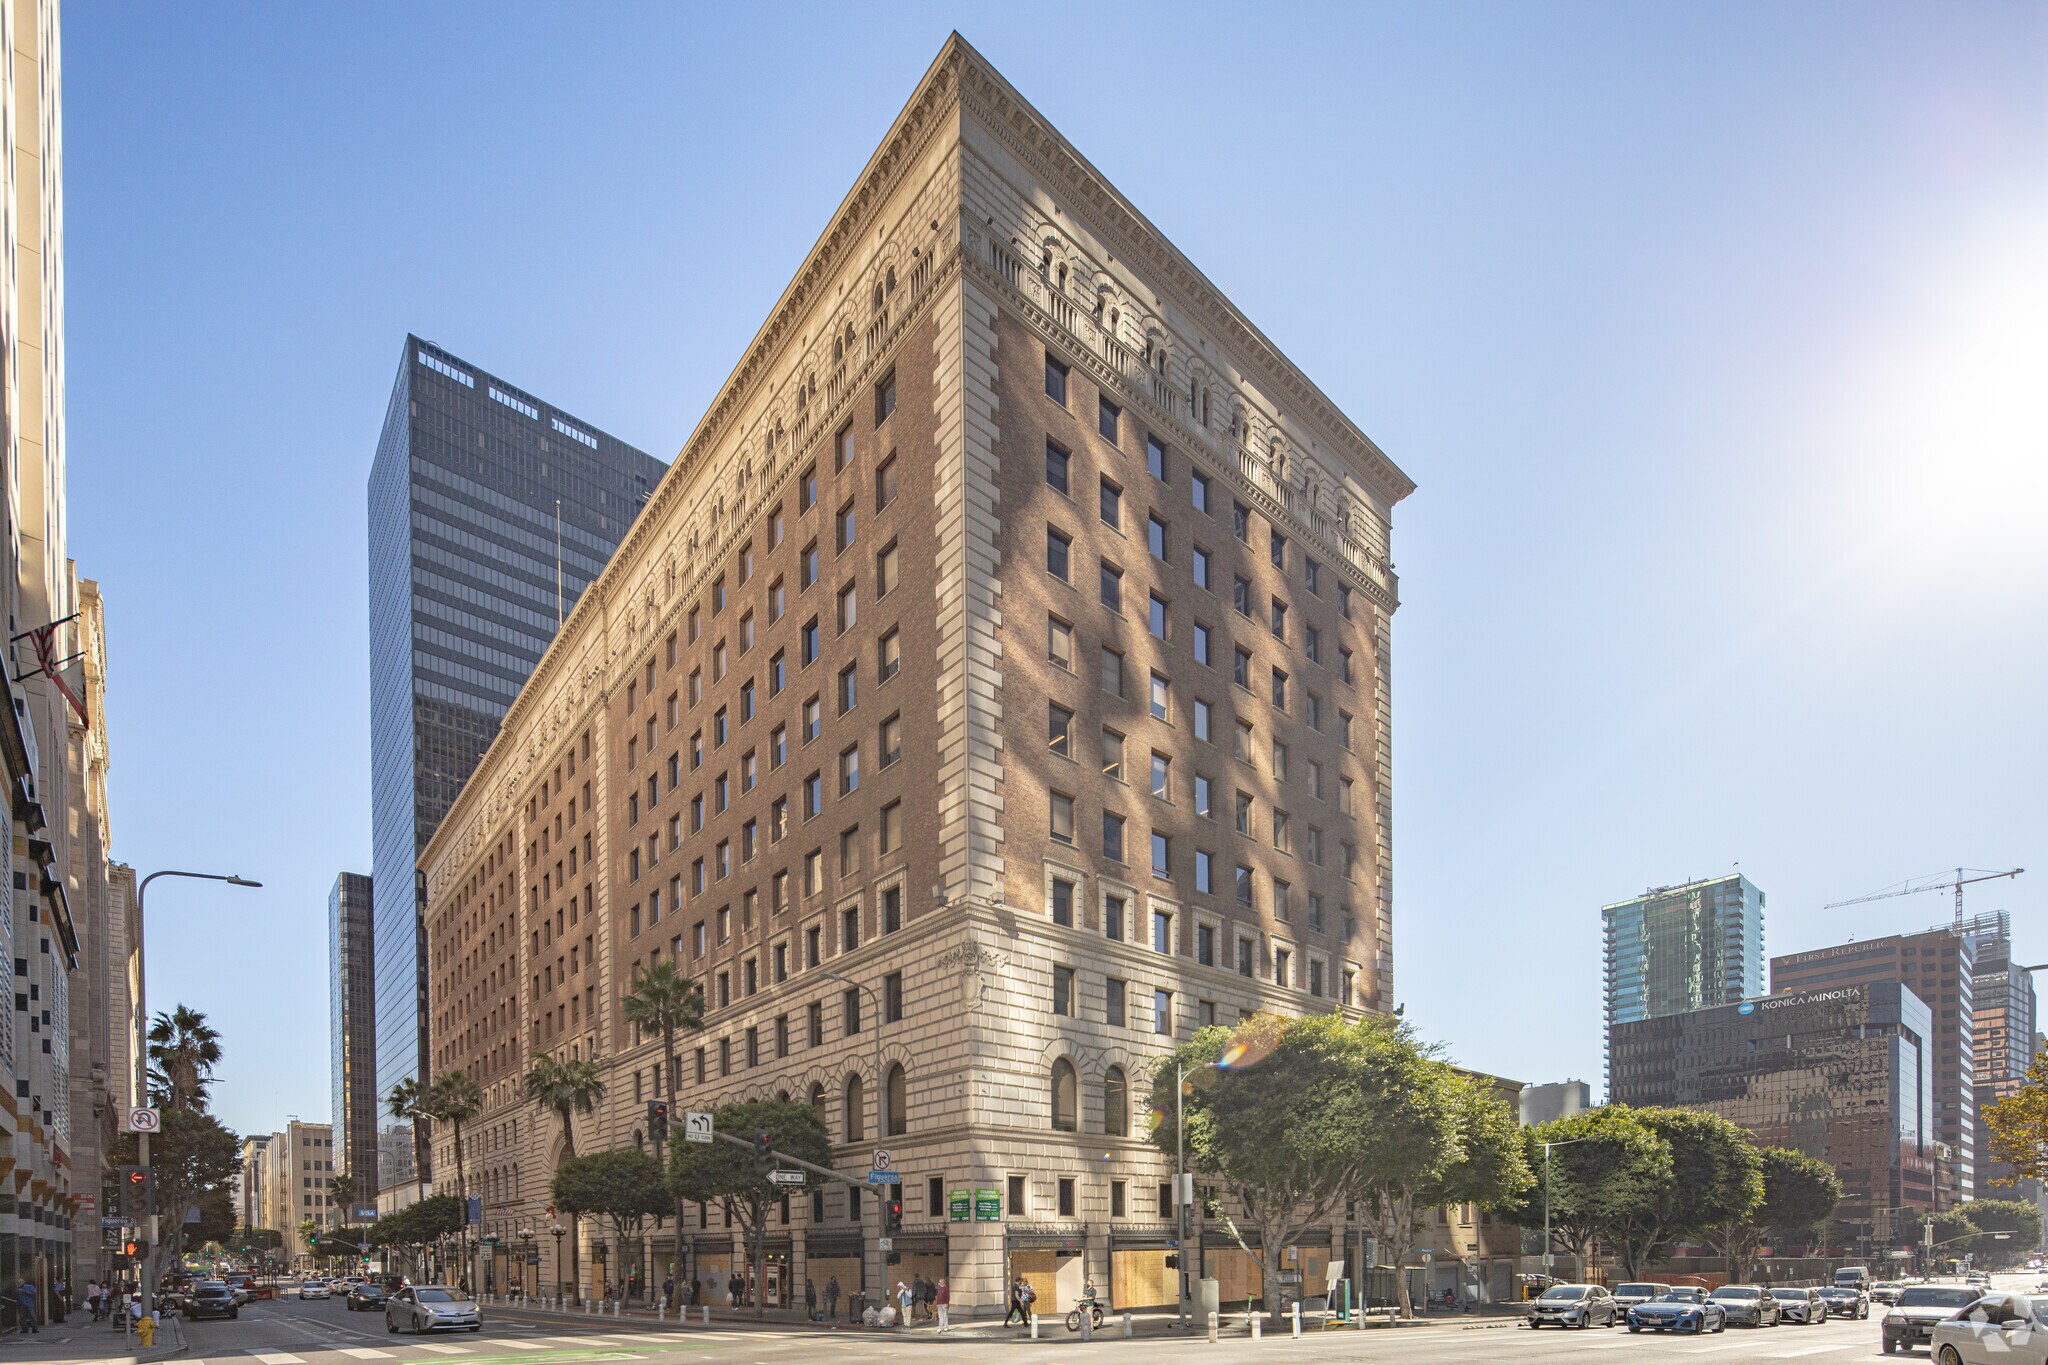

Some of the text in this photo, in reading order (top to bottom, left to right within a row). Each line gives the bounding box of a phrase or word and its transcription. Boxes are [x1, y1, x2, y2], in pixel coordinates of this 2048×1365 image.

[1796, 940, 1888, 963] FIRST REPUBLIC
[1761, 988, 1860, 1011] KONICA MINOLTA
[870, 1173, 898, 1182] Figueroa
[101, 1217, 127, 1225] Figueroa
[1019, 1240, 1033, 1248] Bank
[1040, 1240, 1063, 1248] America
